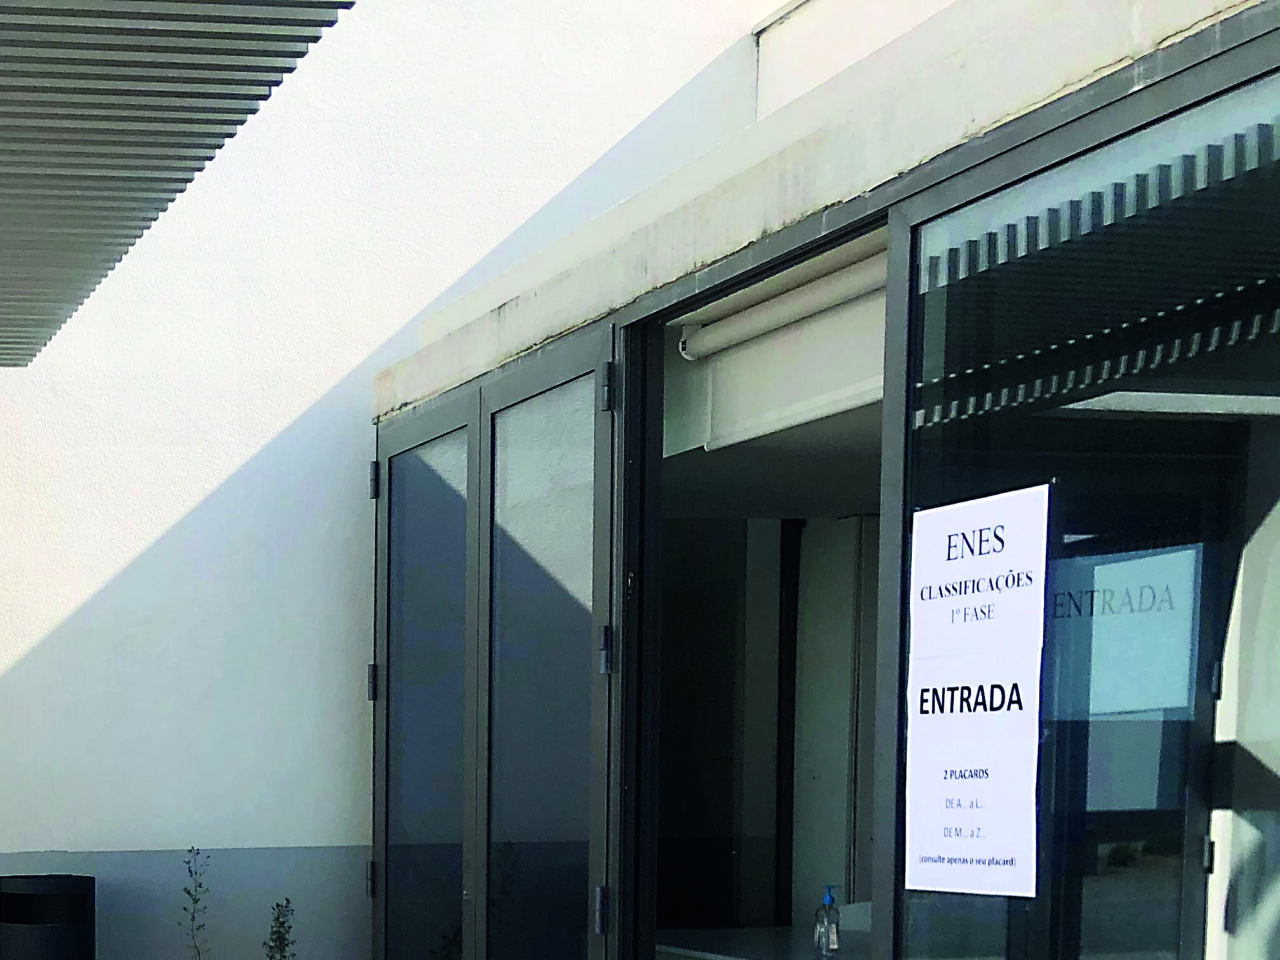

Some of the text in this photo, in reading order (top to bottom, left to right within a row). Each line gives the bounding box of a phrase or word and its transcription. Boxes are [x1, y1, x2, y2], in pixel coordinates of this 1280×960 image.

[946, 525, 1006, 562] ENES
[920, 569, 1034, 602] CLASSIFICAÇÕES
[963, 603, 996, 623] FASE
[1052, 584, 1176, 619] ENTRADA
[920, 682, 1023, 715] ENTRADA
[943, 768, 990, 780] 2 PLACARDS
[945, 798, 955, 809] DE
[943, 827, 953, 838] DE
